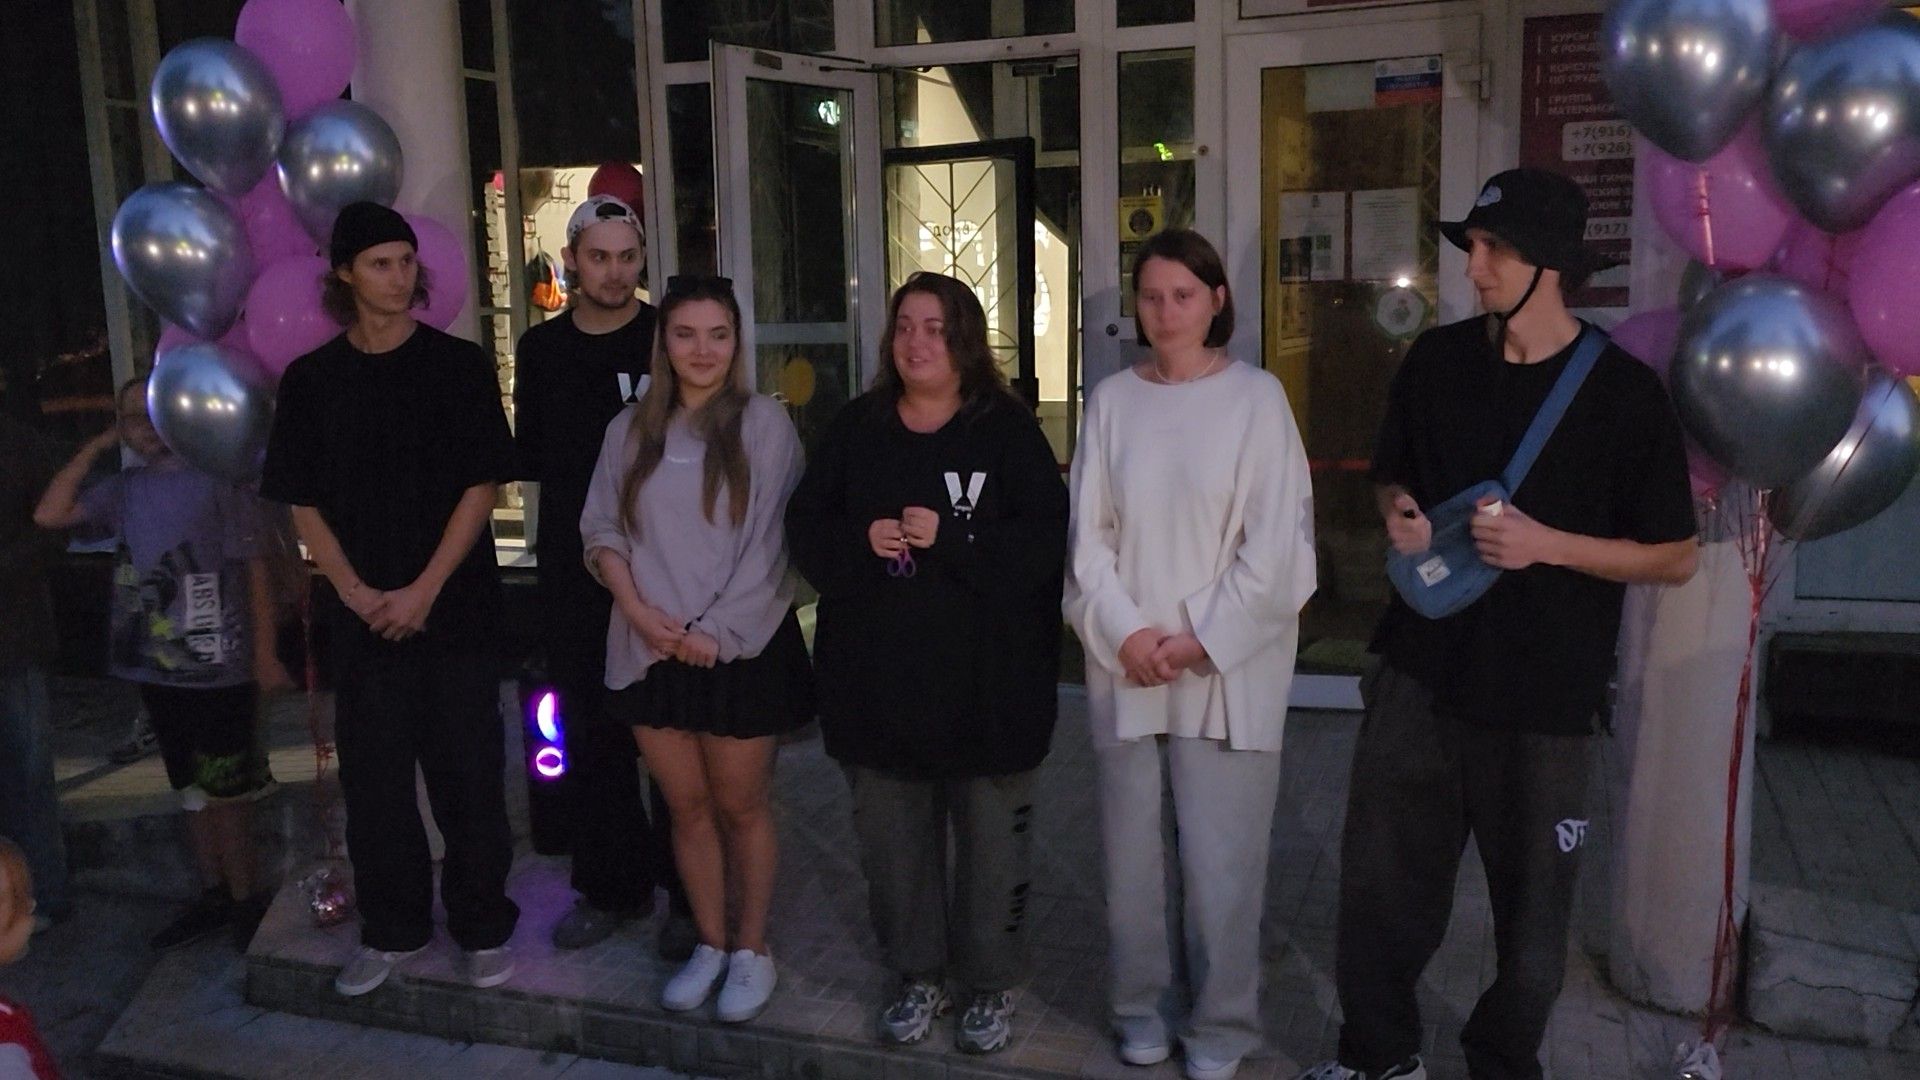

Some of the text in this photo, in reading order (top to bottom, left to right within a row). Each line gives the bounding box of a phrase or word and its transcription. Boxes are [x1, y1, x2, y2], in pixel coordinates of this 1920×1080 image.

[1548, 93, 1592, 105] ГРУППА
[1571, 125, 1632, 140] +7(916)
[1570, 142, 1632, 157] +7(926)
